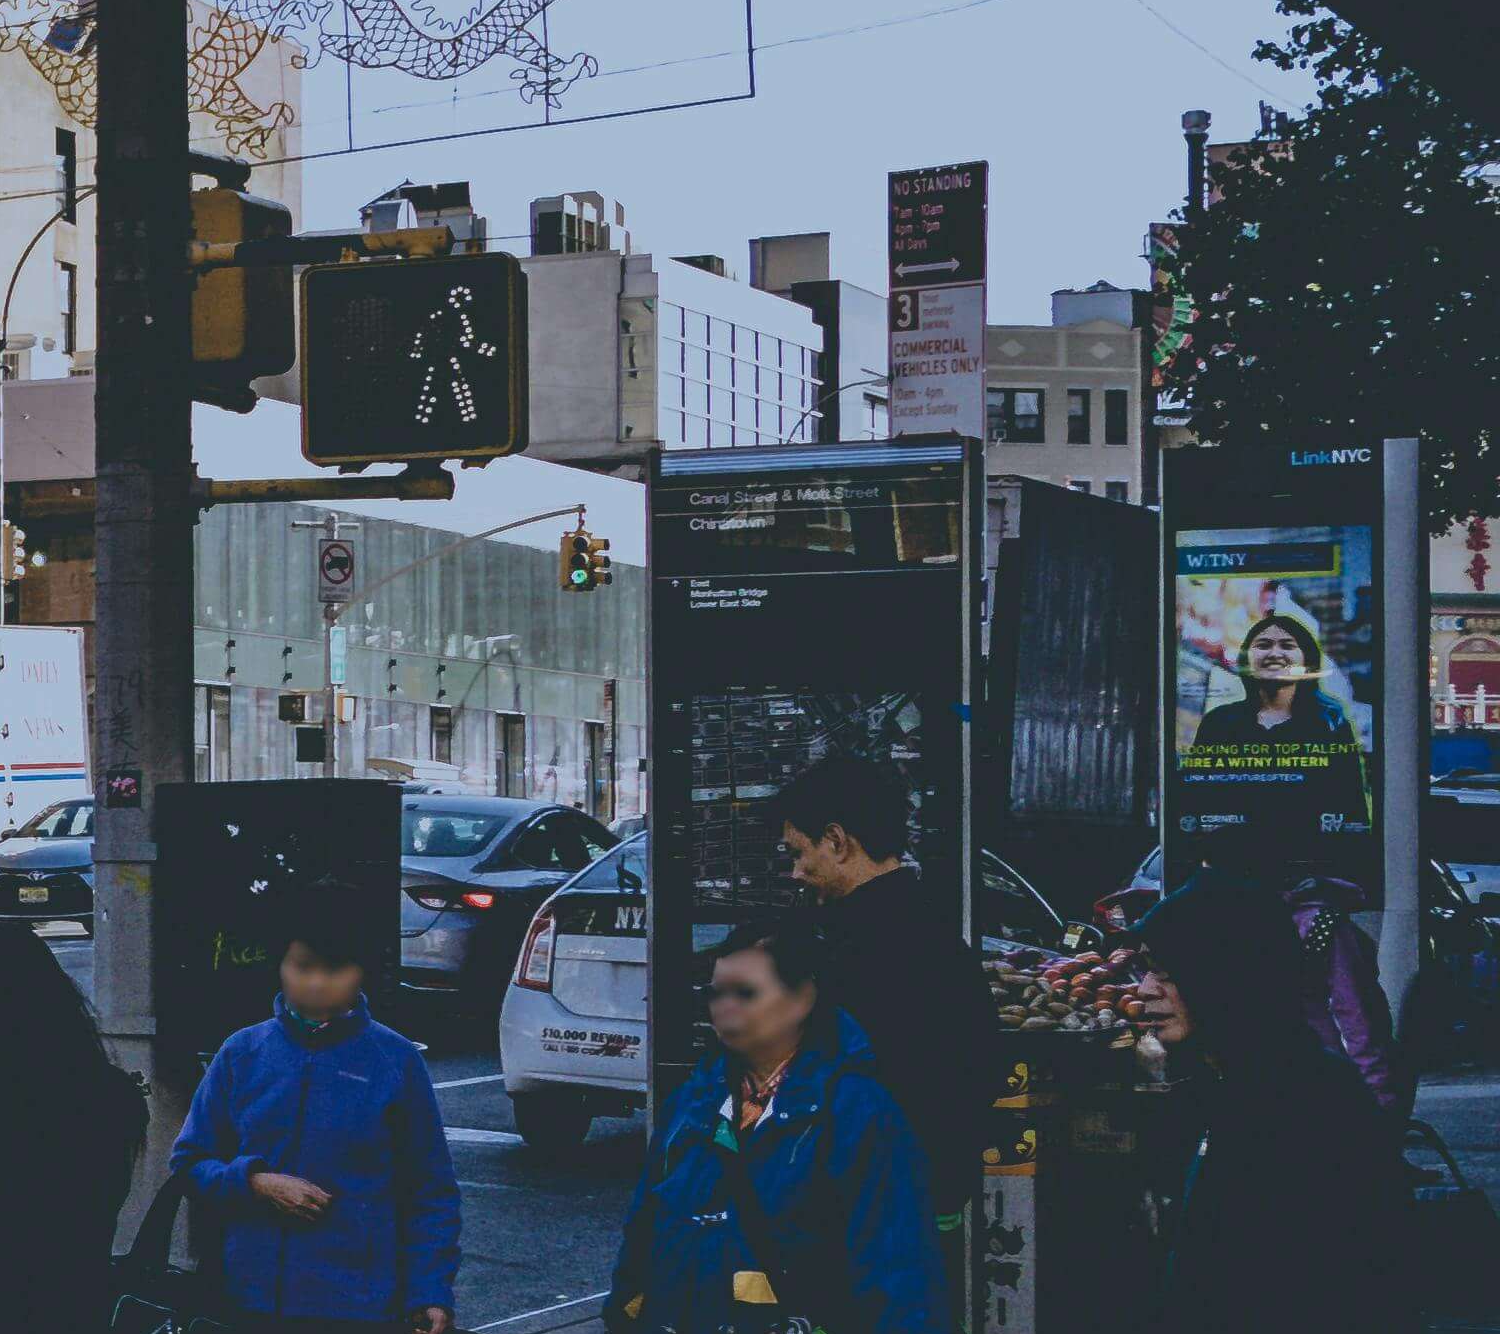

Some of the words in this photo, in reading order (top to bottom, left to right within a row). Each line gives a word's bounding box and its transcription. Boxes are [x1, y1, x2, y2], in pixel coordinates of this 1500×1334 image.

[894, 180, 910, 196] NO
[913, 172, 972, 194] STANDING
[896, 294, 913, 329] 3
[894, 338, 967, 357] COMMERCIAL
[894, 358, 947, 378] VEHICLES
[951, 356, 980, 375] ONLY
[1291, 448, 1372, 466] LinkNYC
[690, 491, 729, 506] Canal
[734, 489, 778, 504] Street
[797, 487, 830, 501] Mott
[833, 486, 880, 500] Street
[690, 515, 766, 531] Chinatown
[21, 660, 60, 683] DAILY
[1243, 743, 1270, 755] FOR
[1274, 743, 1300, 754] TOP
[1180, 757, 1213, 768] HIRE
[1276, 756, 1329, 767] INTERN
[613, 906, 647, 930] NY
[590, 1031, 641, 1046] REWARD
